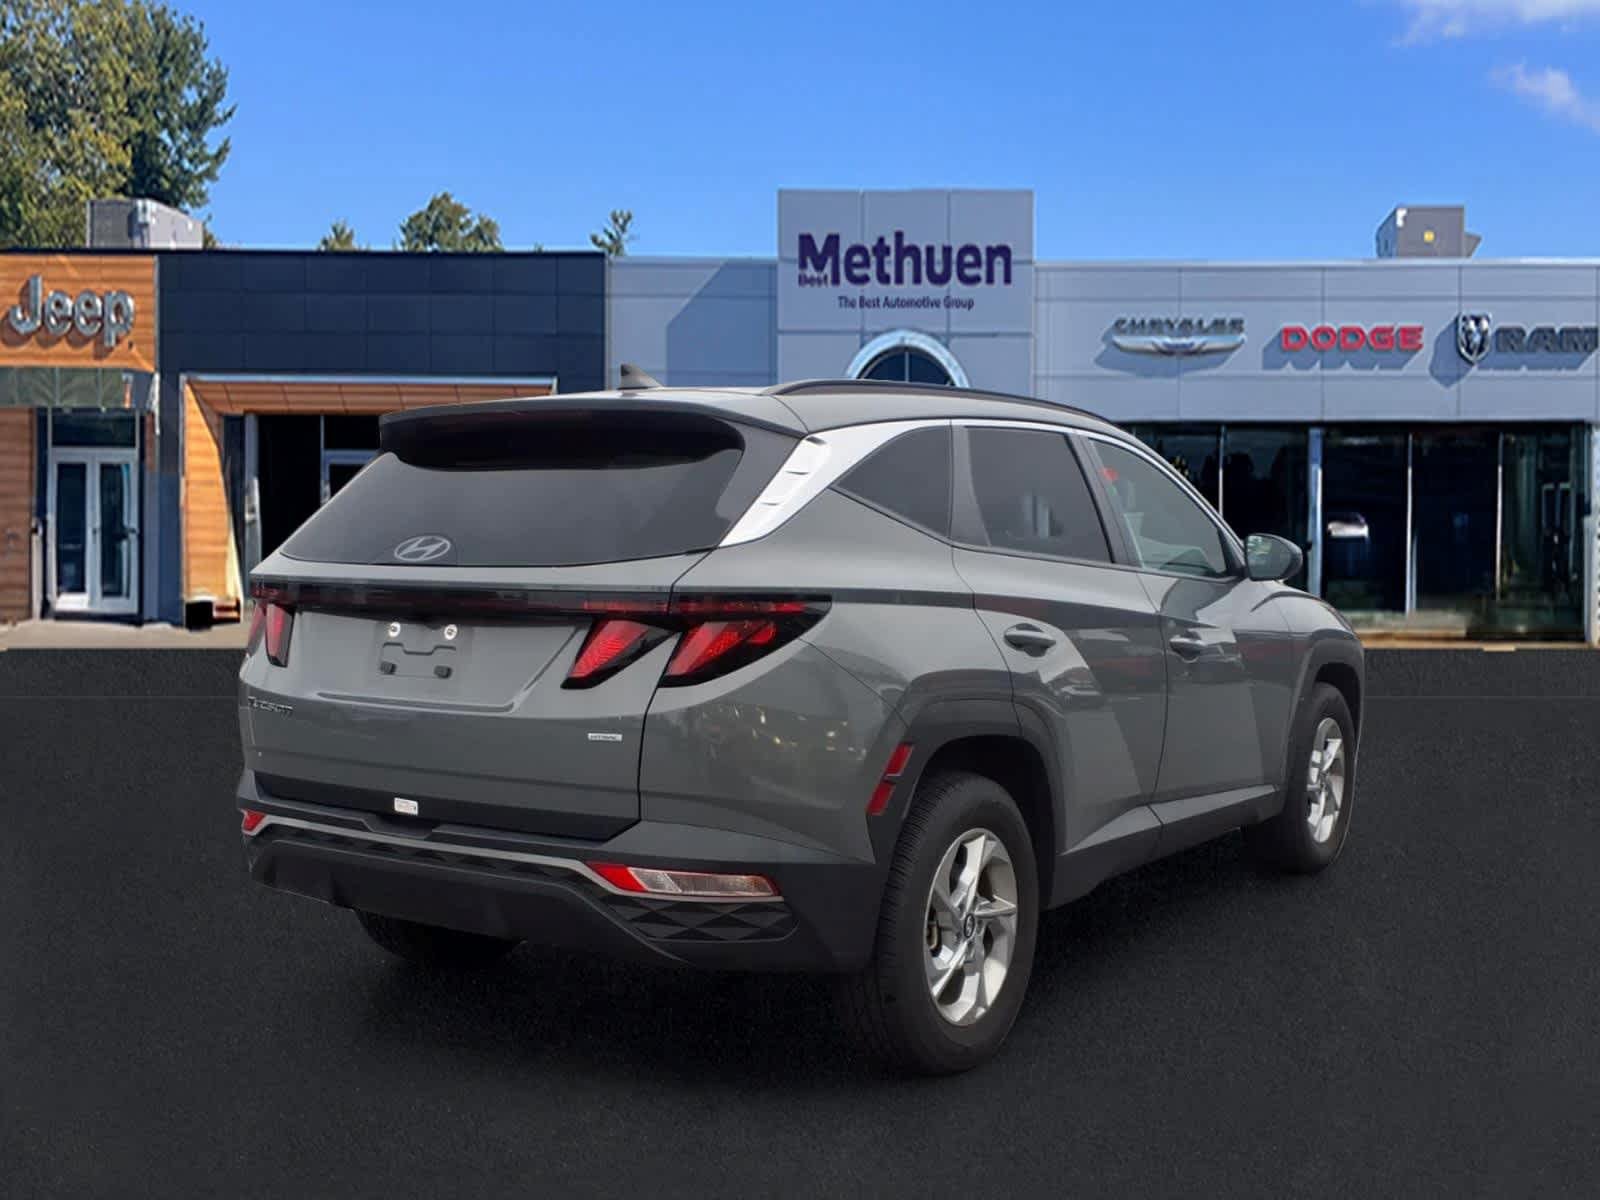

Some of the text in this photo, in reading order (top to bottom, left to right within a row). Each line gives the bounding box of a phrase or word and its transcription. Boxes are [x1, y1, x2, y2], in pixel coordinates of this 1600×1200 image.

[798, 229, 1013, 286] Methuen
[9, 274, 135, 347] Jeep
[838, 296, 975, 311] The Best Automotive Group
[1280, 325, 1424, 353] DODGE
[1495, 326, 1599, 353] RAM
